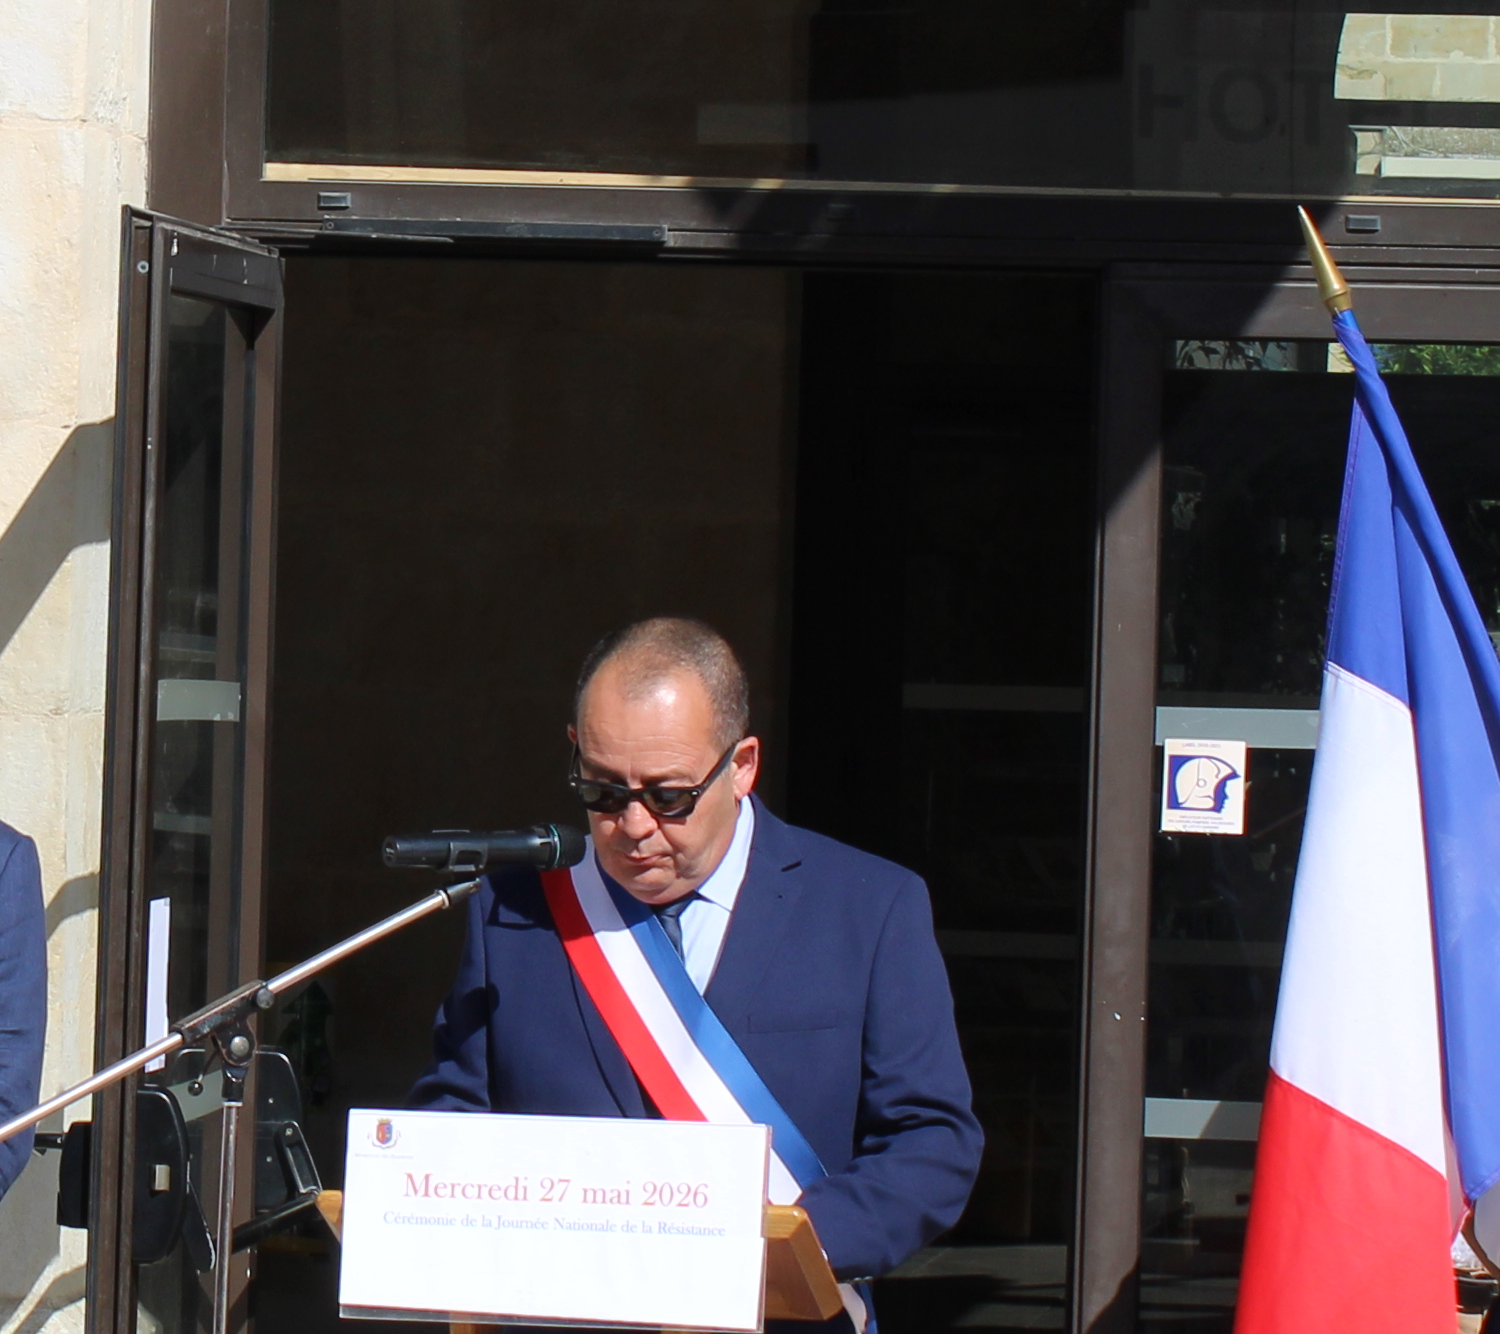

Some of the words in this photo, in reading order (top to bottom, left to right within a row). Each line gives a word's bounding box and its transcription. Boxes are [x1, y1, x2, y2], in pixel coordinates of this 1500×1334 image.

[402, 1171, 530, 1203] Mercredi
[540, 1176, 572, 1203] 27
[580, 1179, 633, 1207] mai
[640, 1180, 710, 1209] 2026
[382, 1210, 457, 1228] Cérémonie
[460, 1213, 479, 1228] de
[481, 1214, 493, 1229] la
[493, 1214, 549, 1231] Journée
[552, 1217, 618, 1234] Nationale
[620, 1219, 639, 1234] de
[641, 1220, 654, 1235] la
[656, 1220, 727, 1238] Résistance
